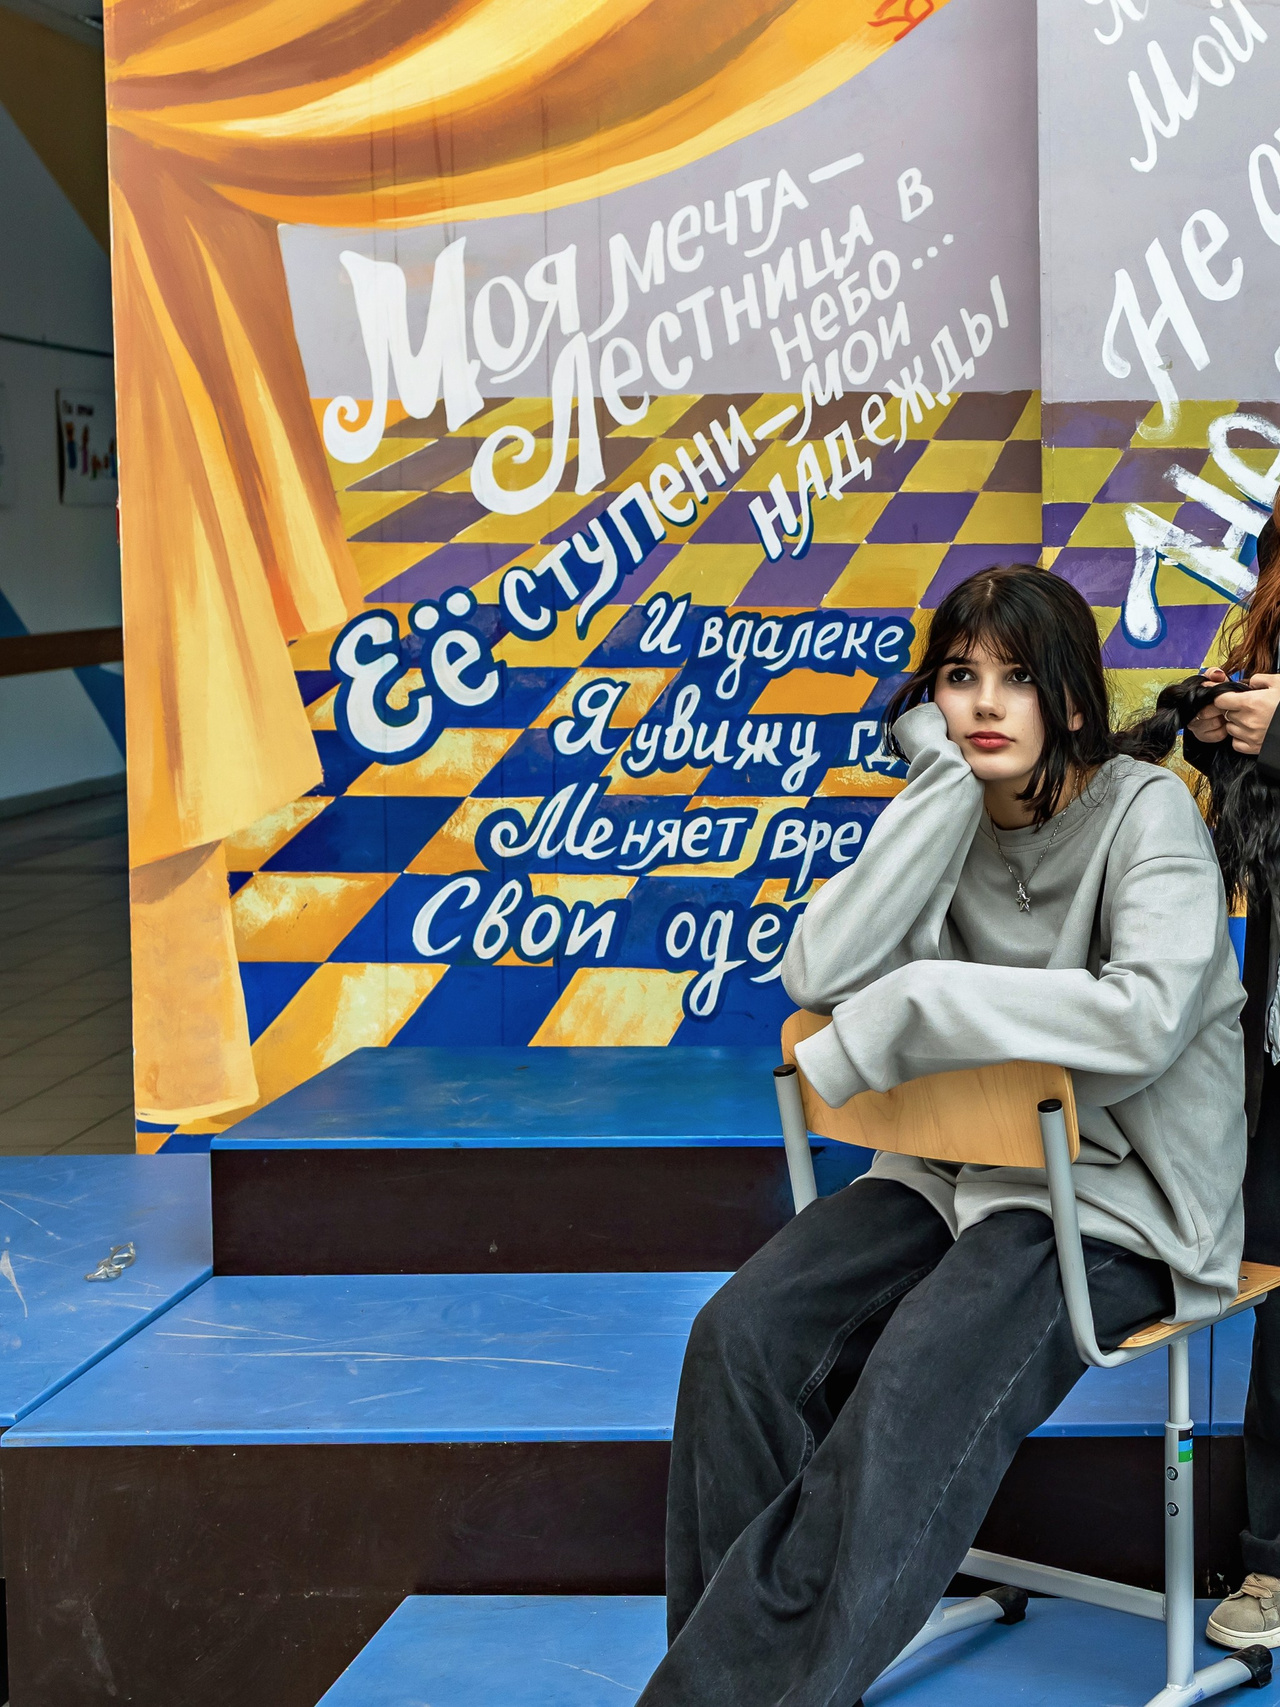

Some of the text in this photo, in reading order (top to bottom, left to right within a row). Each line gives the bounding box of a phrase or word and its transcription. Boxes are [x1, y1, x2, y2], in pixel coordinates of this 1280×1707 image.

[1102, 208, 1243, 441] Не
[638, 593, 904, 698] И вдалеке
[553, 678, 629, 757] Я
[627, 684, 821, 792] увижу
[769, 818, 863, 894] вре
[412, 876, 803, 1016] Свои оде
